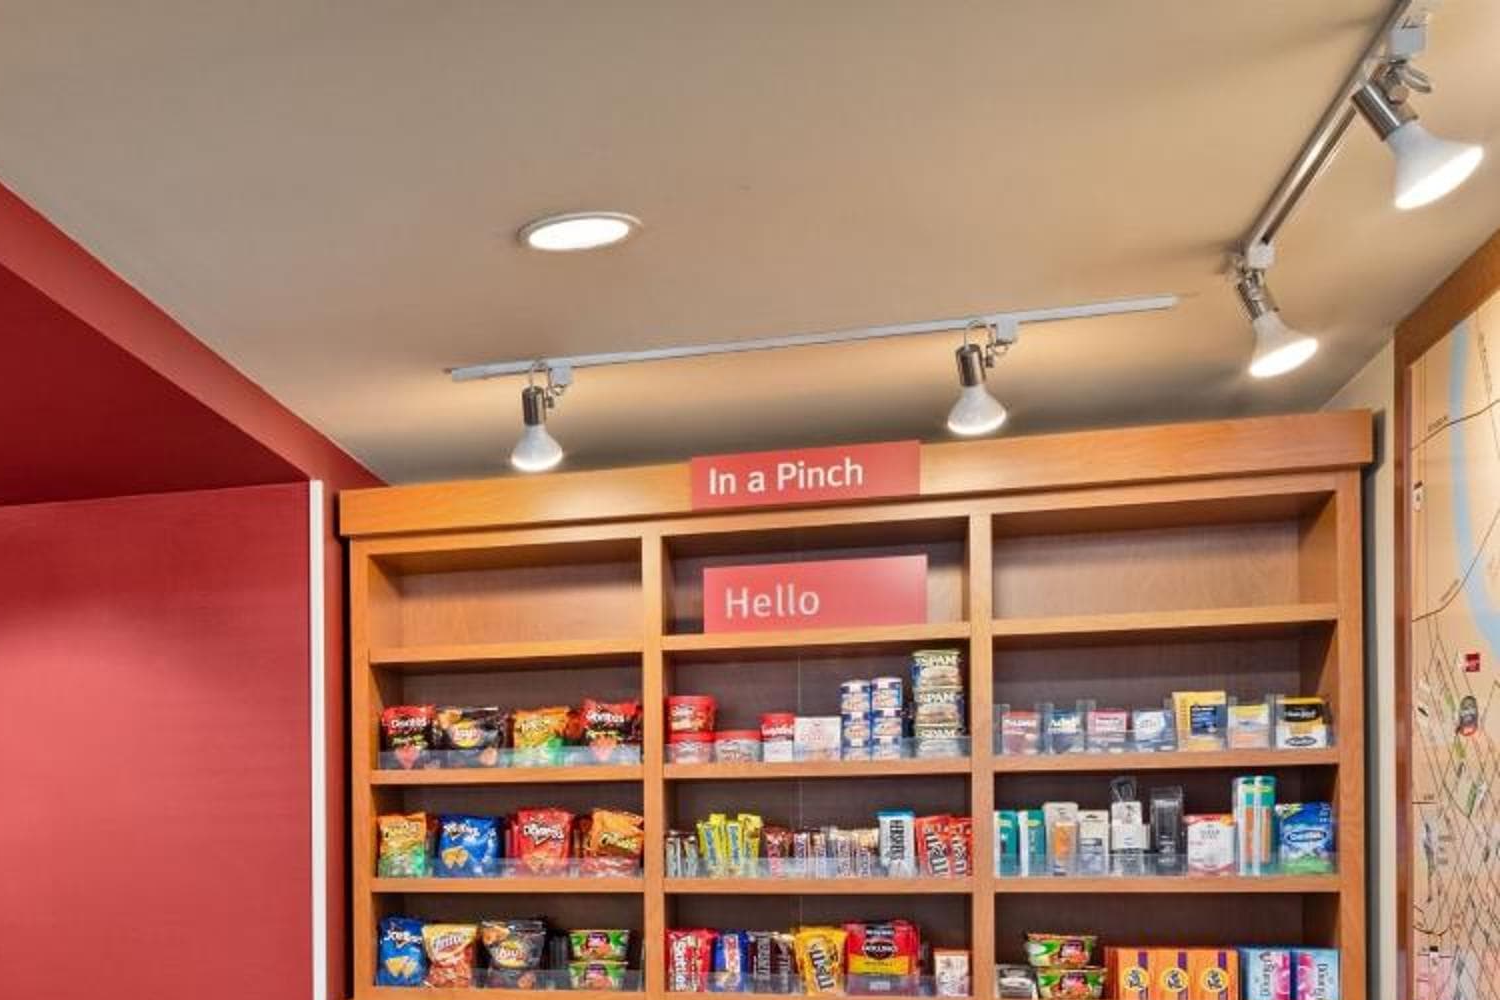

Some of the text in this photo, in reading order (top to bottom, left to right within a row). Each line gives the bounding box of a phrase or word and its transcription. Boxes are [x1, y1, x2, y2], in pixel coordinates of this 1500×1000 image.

[708, 457, 864, 495] In a Pinch
[724, 583, 820, 619] Hello
[919, 653, 958, 667] SPAM
[918, 691, 955, 704] SPAM
